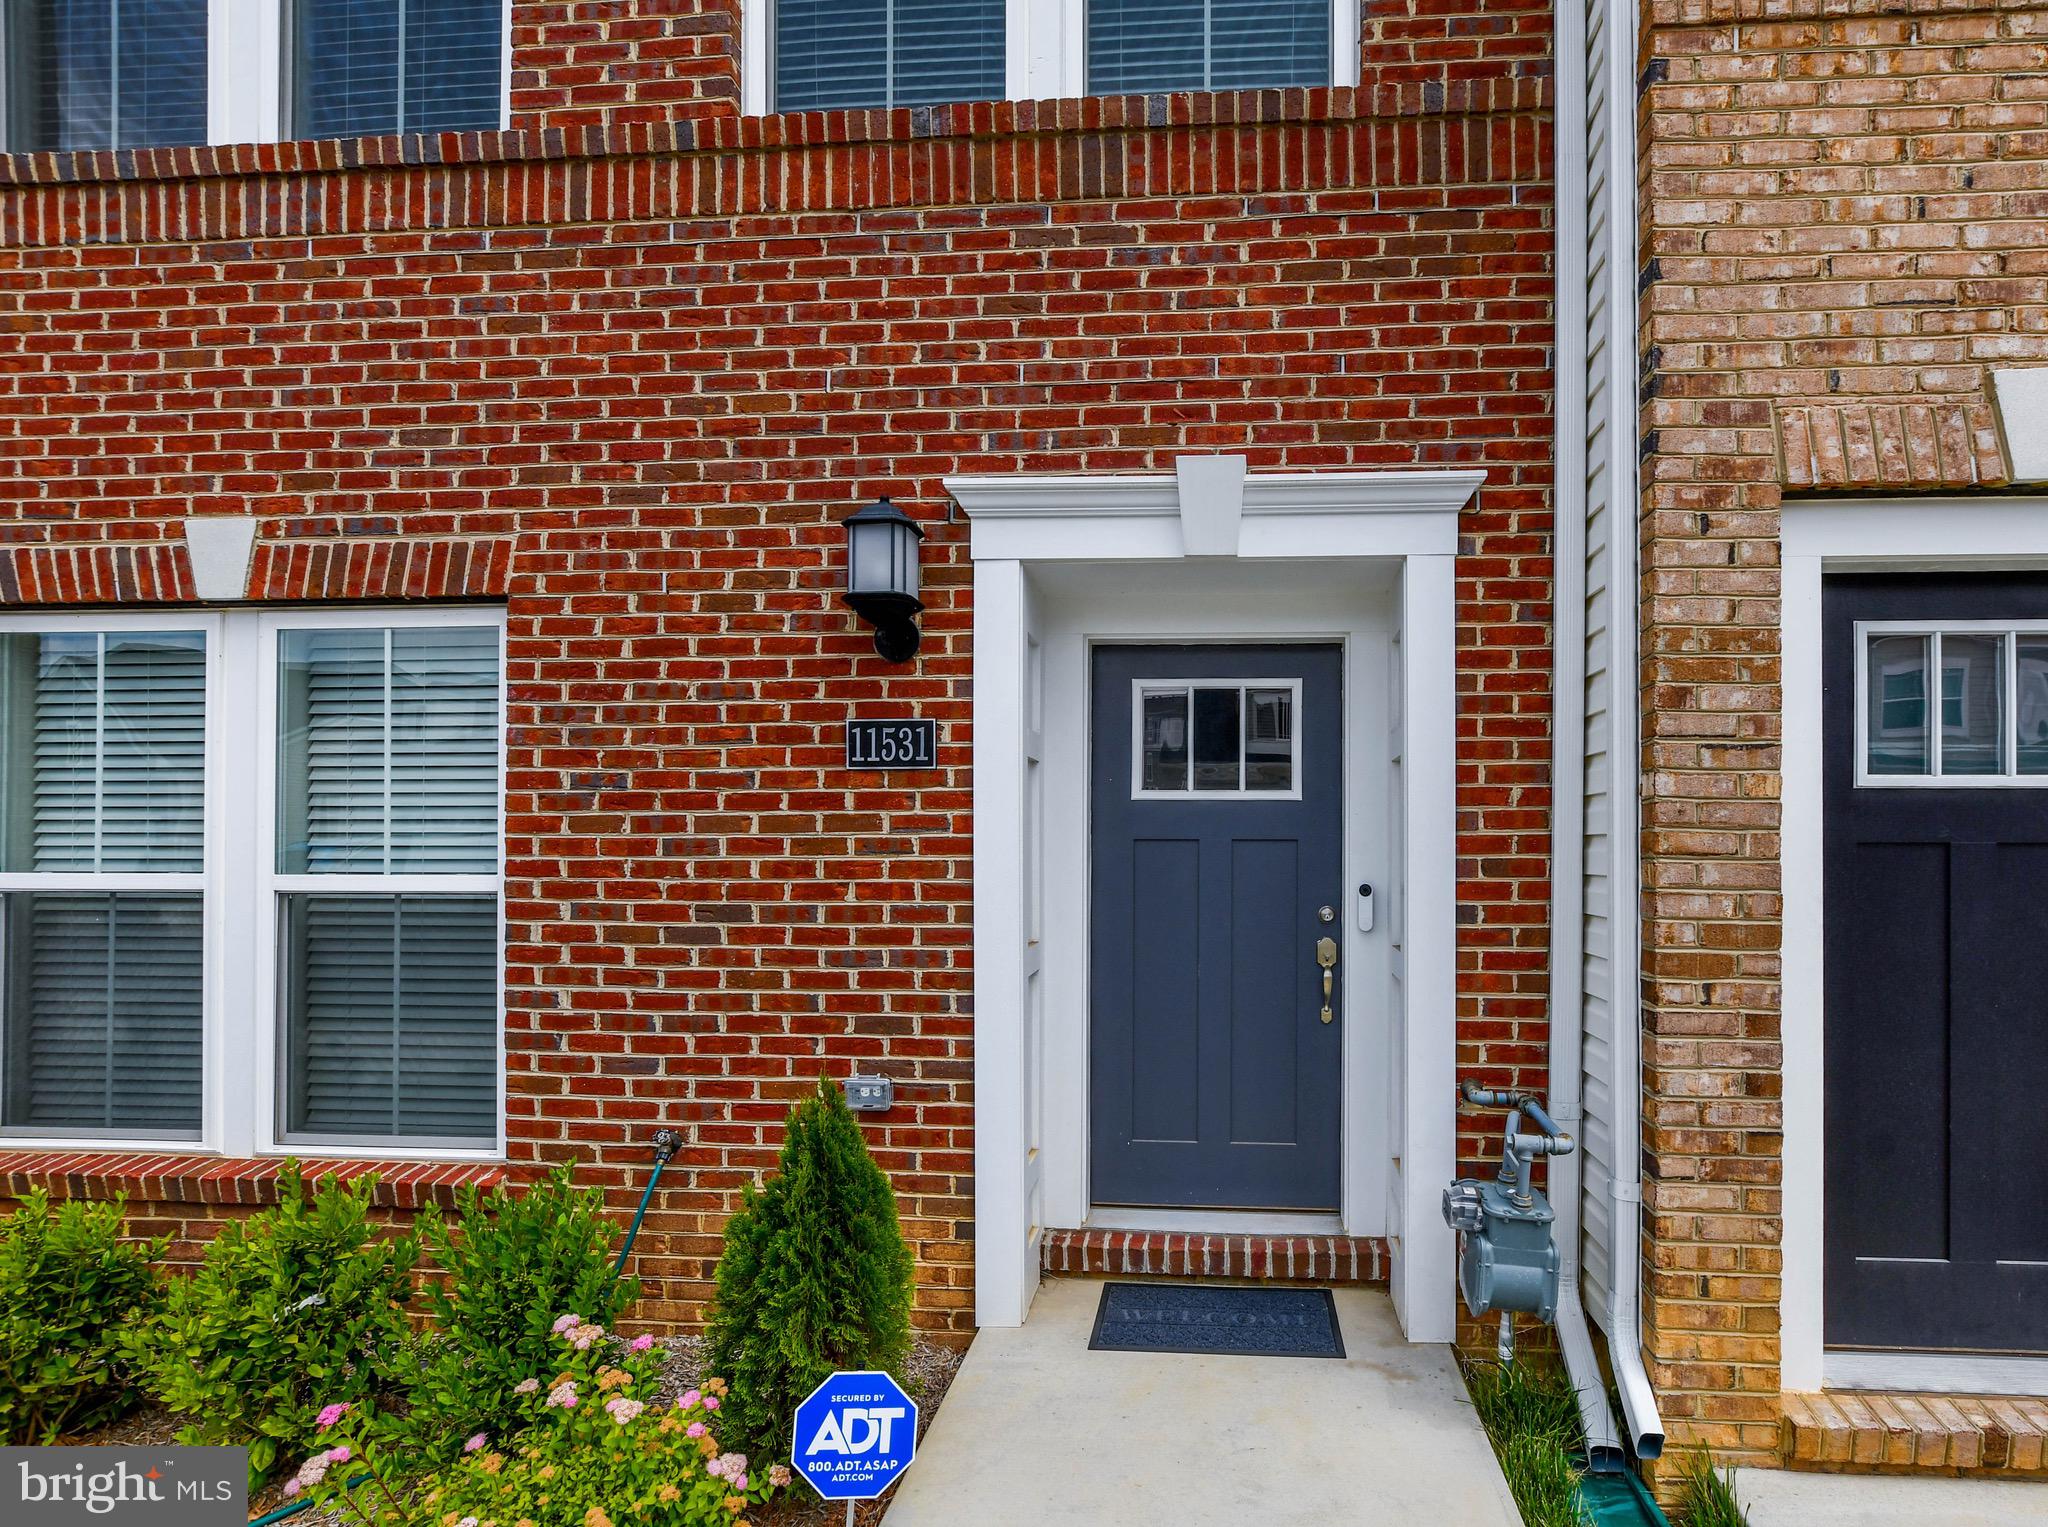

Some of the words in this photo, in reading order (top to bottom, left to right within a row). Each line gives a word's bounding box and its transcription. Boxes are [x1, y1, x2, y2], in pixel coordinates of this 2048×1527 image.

[851, 727, 929, 762] 11531
[831, 1394, 871, 1402] SECURED
[805, 1407, 905, 1455] ADT
[808, 1460, 898, 1472] 800.ADT.ASAP
[832, 1474, 873, 1482] ADT.COM
